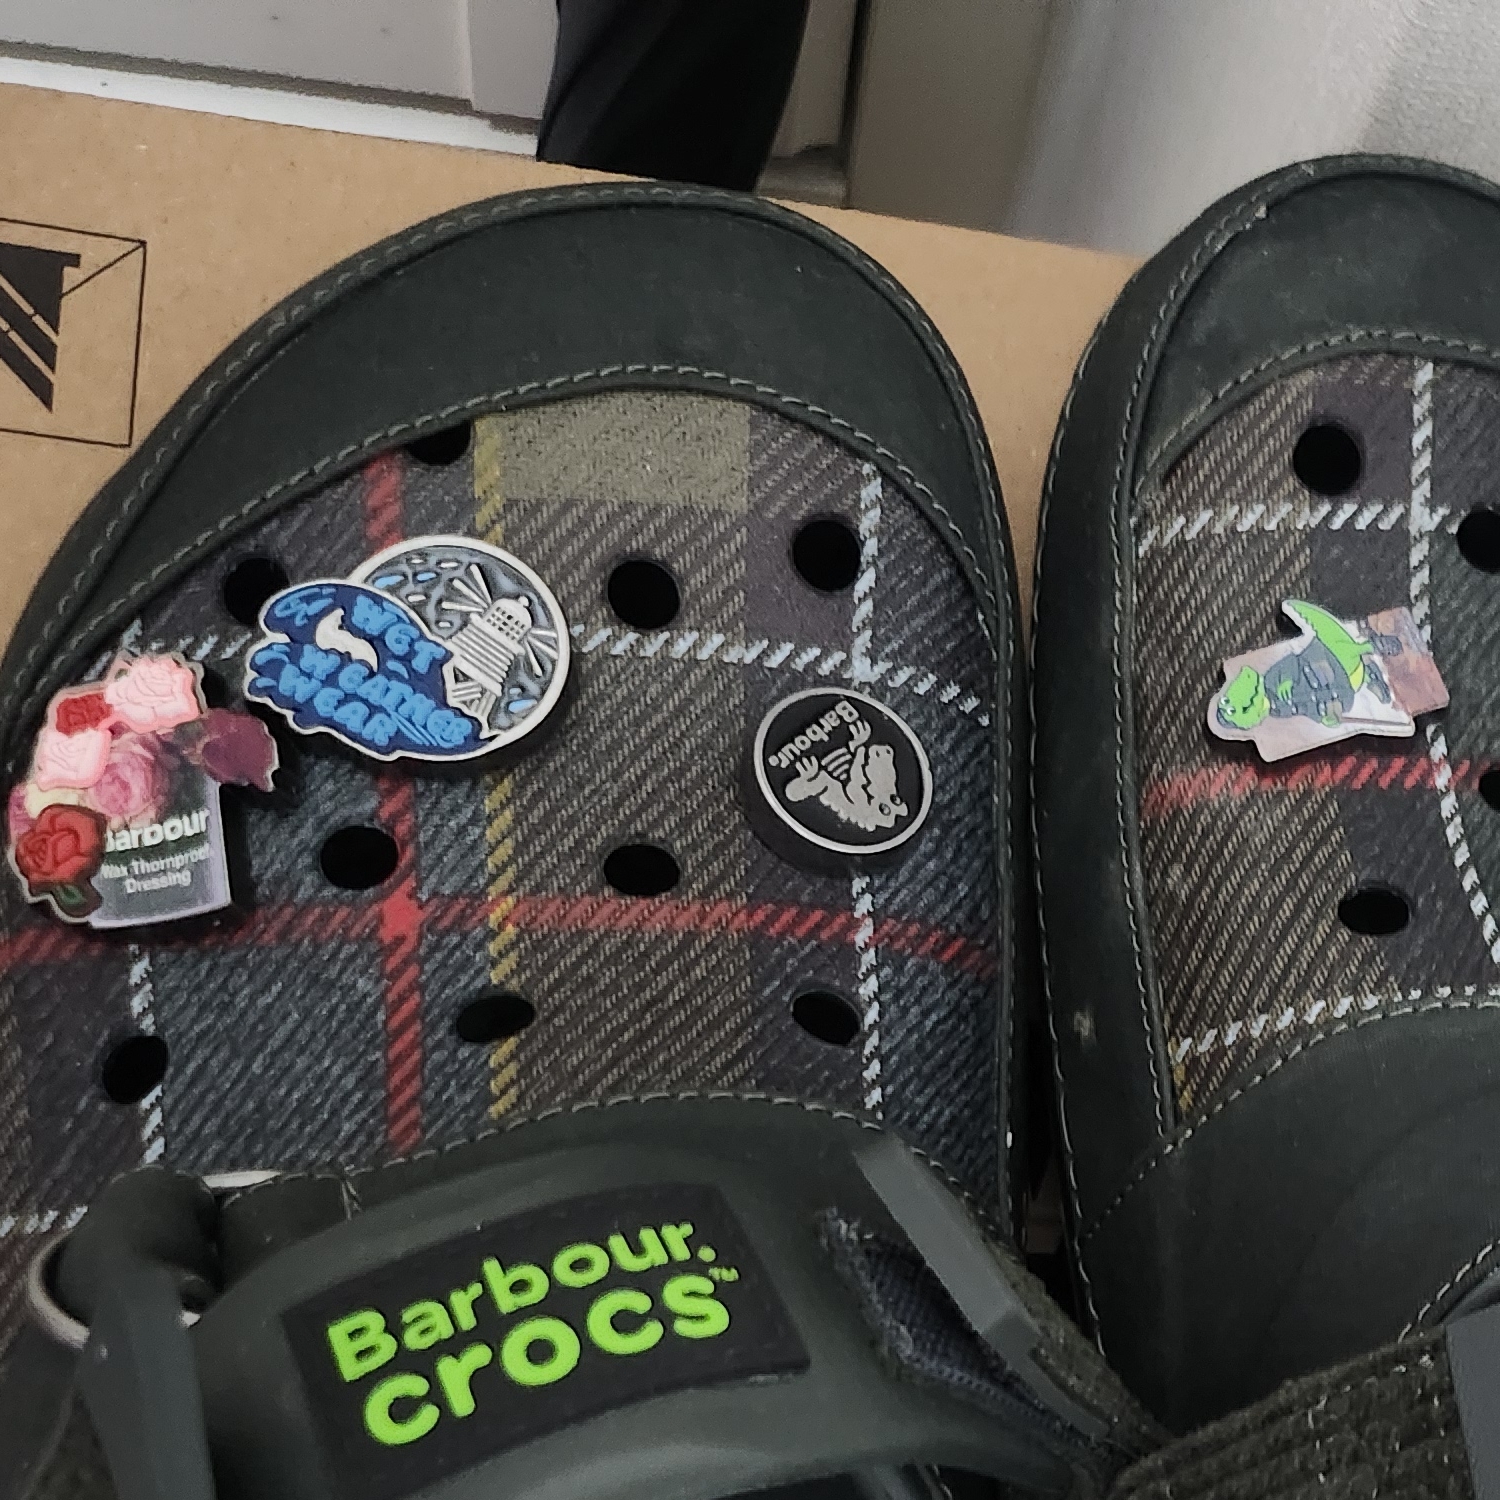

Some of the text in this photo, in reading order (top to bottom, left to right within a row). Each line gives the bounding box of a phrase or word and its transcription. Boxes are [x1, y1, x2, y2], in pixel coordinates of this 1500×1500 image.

[351, 594, 447, 675] WET
[278, 663, 399, 747] WEAR
[124, 868, 193, 895] Dressing
